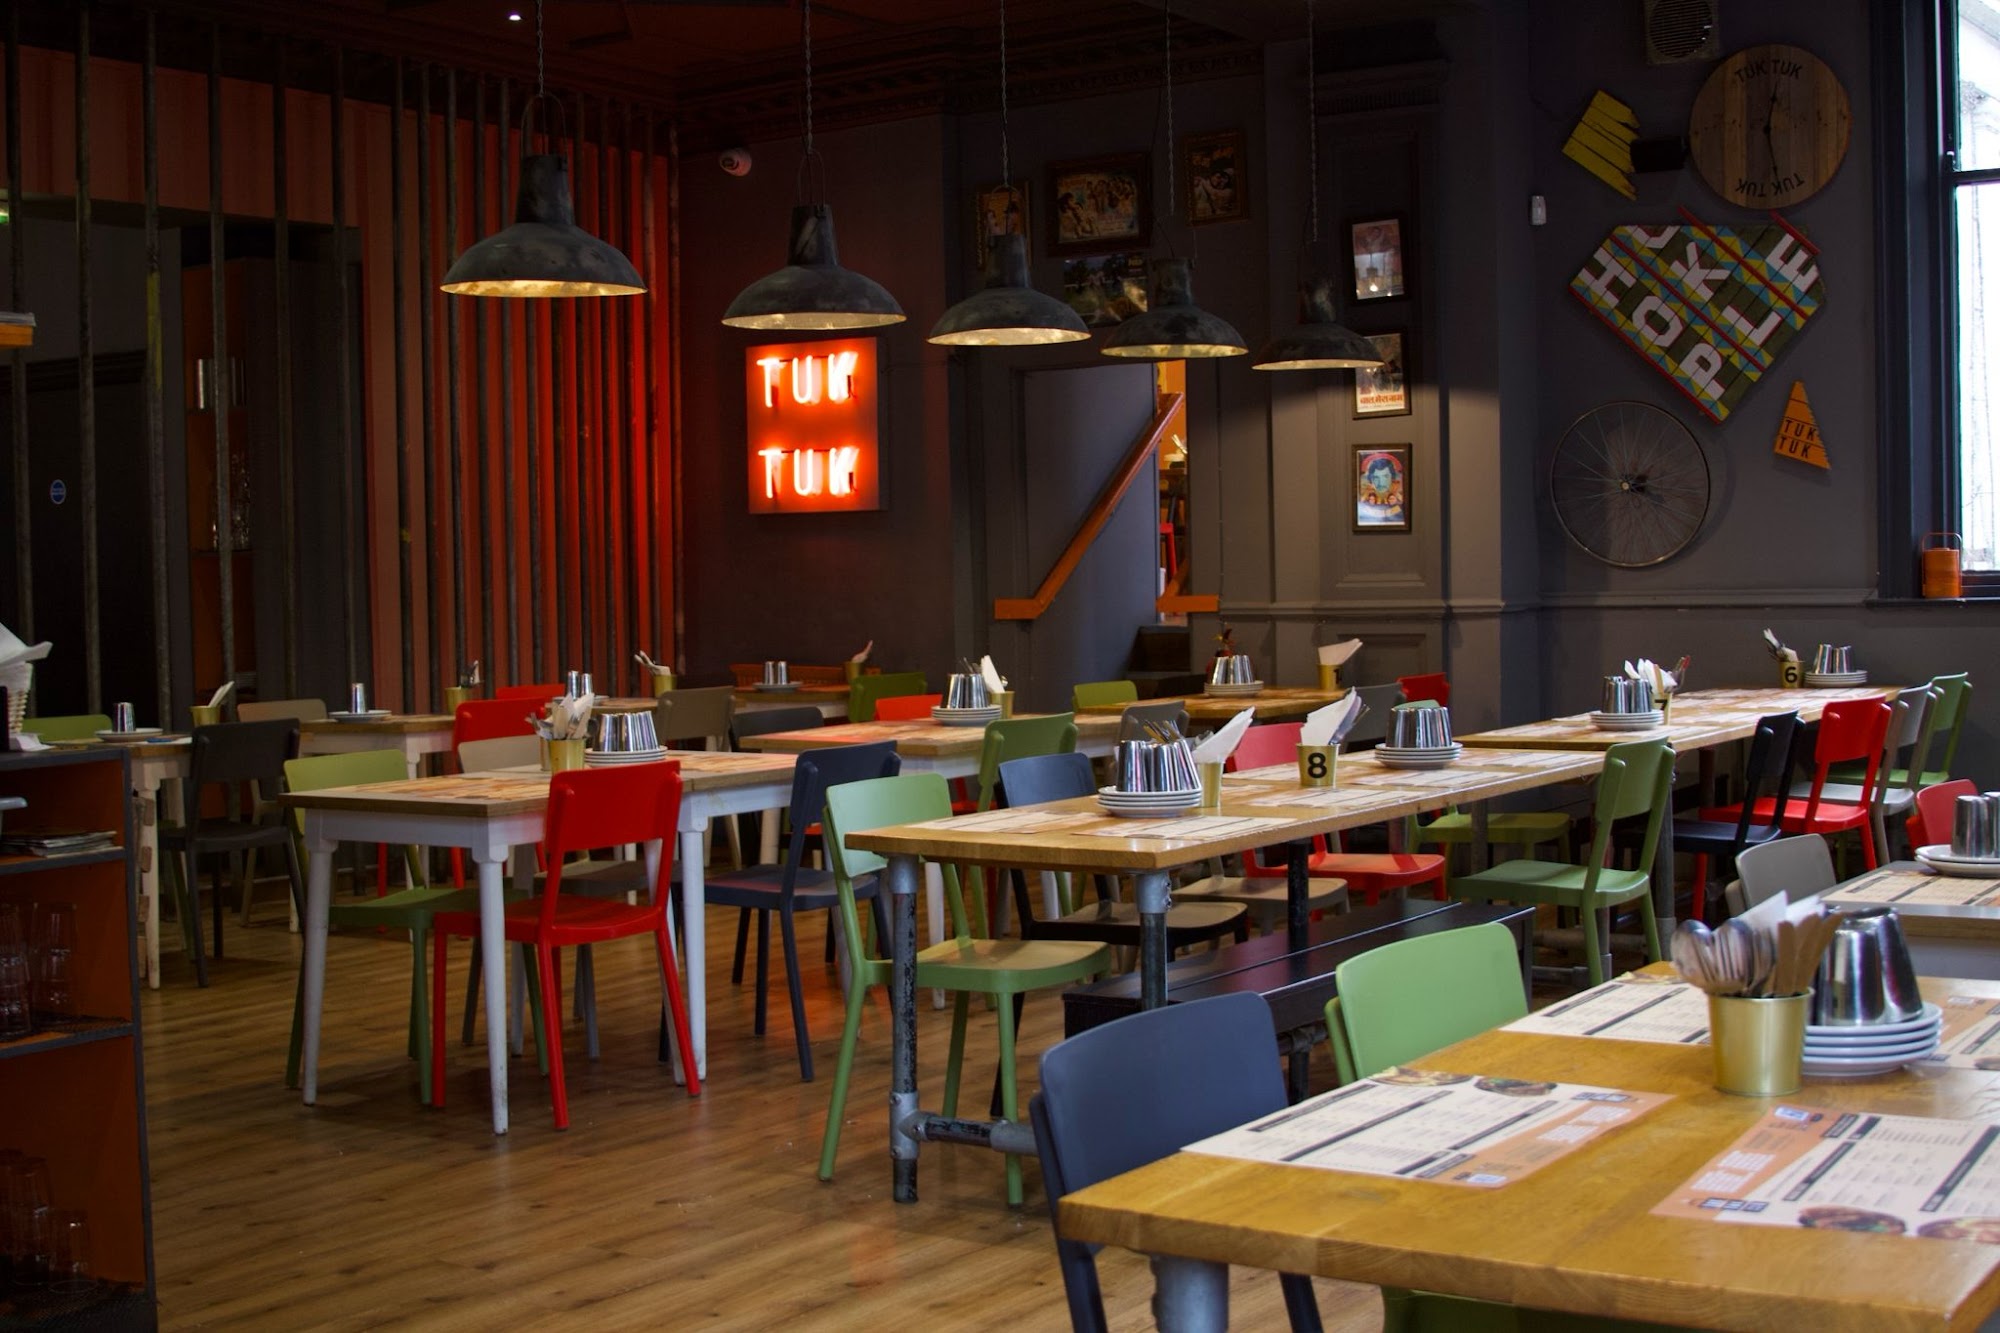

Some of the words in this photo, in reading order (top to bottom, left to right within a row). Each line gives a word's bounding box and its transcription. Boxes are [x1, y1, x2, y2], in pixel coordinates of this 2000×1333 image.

[1734, 60, 1767, 82] TUK
[1772, 59, 1802, 80] TUK
[1735, 178, 1767, 197] TUK
[1771, 173, 1805, 196] TUK
[757, 351, 859, 408] TUK
[1785, 420, 1816, 441] TUK
[1780, 436, 1811, 458] TUK
[758, 447, 860, 498] TUK
[1785, 666, 1798, 683] 6
[1308, 752, 1327, 778] 8
